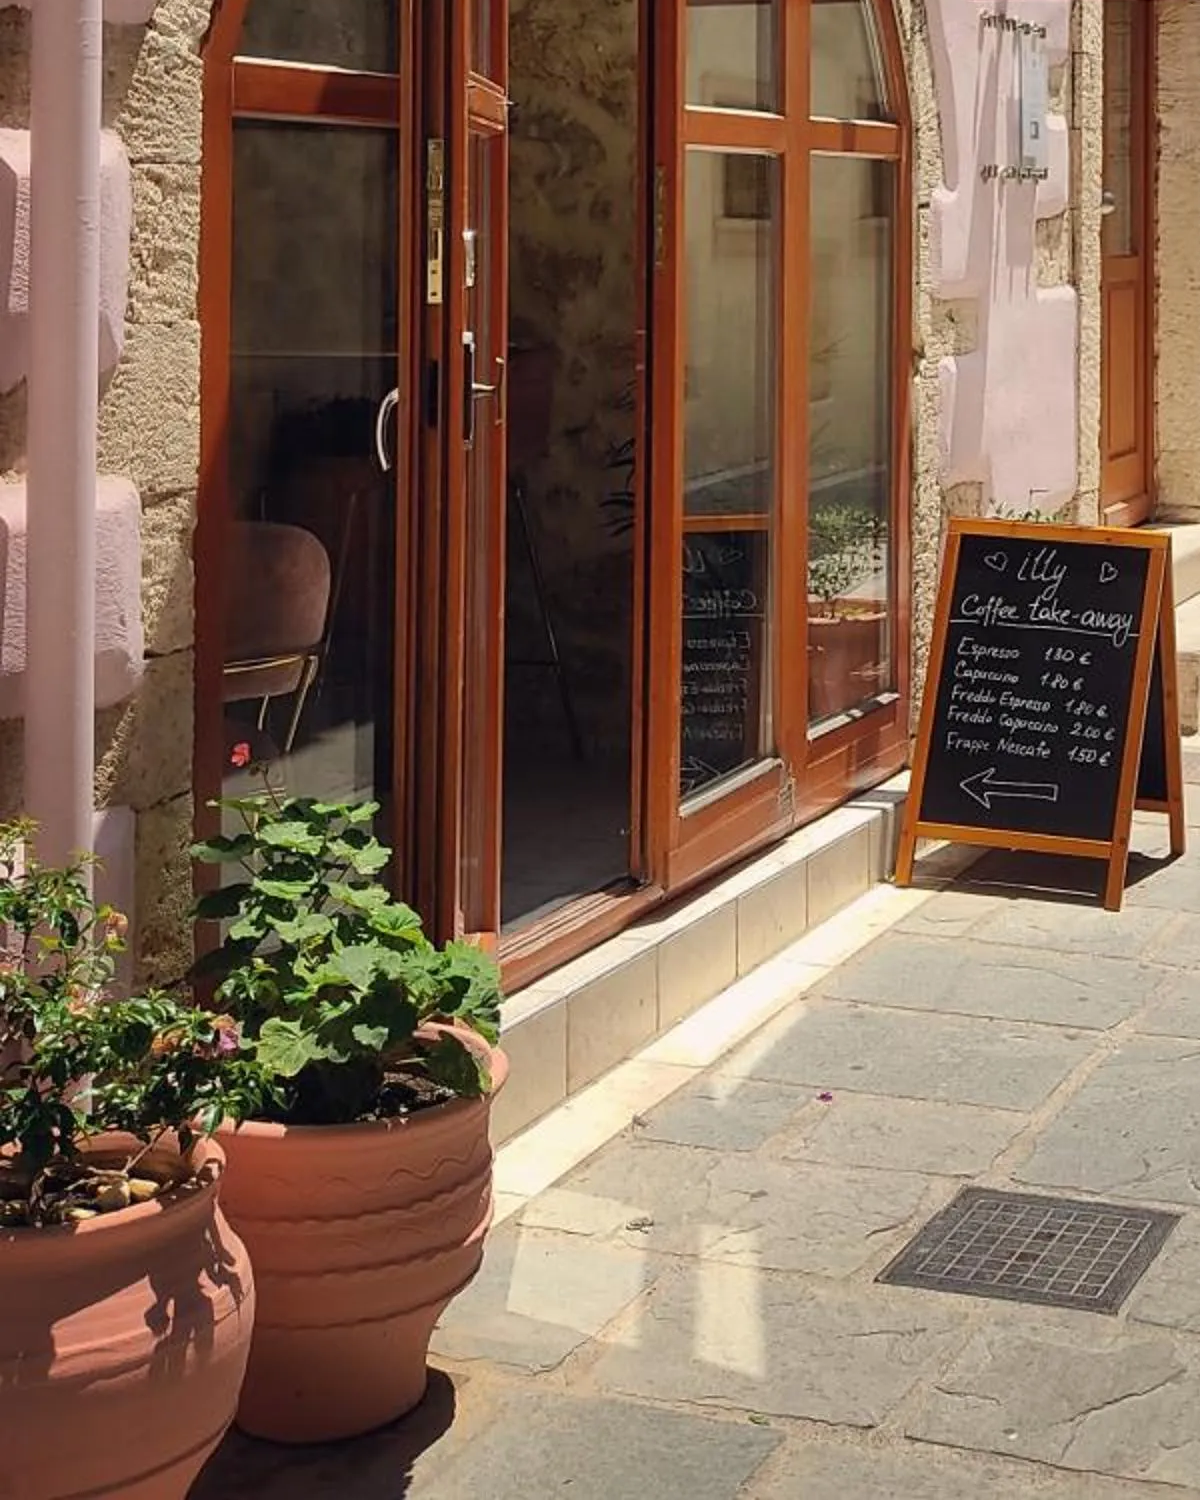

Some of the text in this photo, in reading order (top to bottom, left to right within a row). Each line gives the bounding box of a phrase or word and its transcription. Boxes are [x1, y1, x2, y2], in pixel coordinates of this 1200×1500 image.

[1017, 547, 1068, 600] illy
[961, 593, 1134, 647] Coffee take-away
[957, 636, 1021, 663] Espresso
[1079, 651, 1092, 665] €
[951, 684, 997, 704] Freddo
[999, 691, 1052, 712] Espresso
[947, 705, 993, 724] Freddo
[1099, 751, 1112, 767] €
